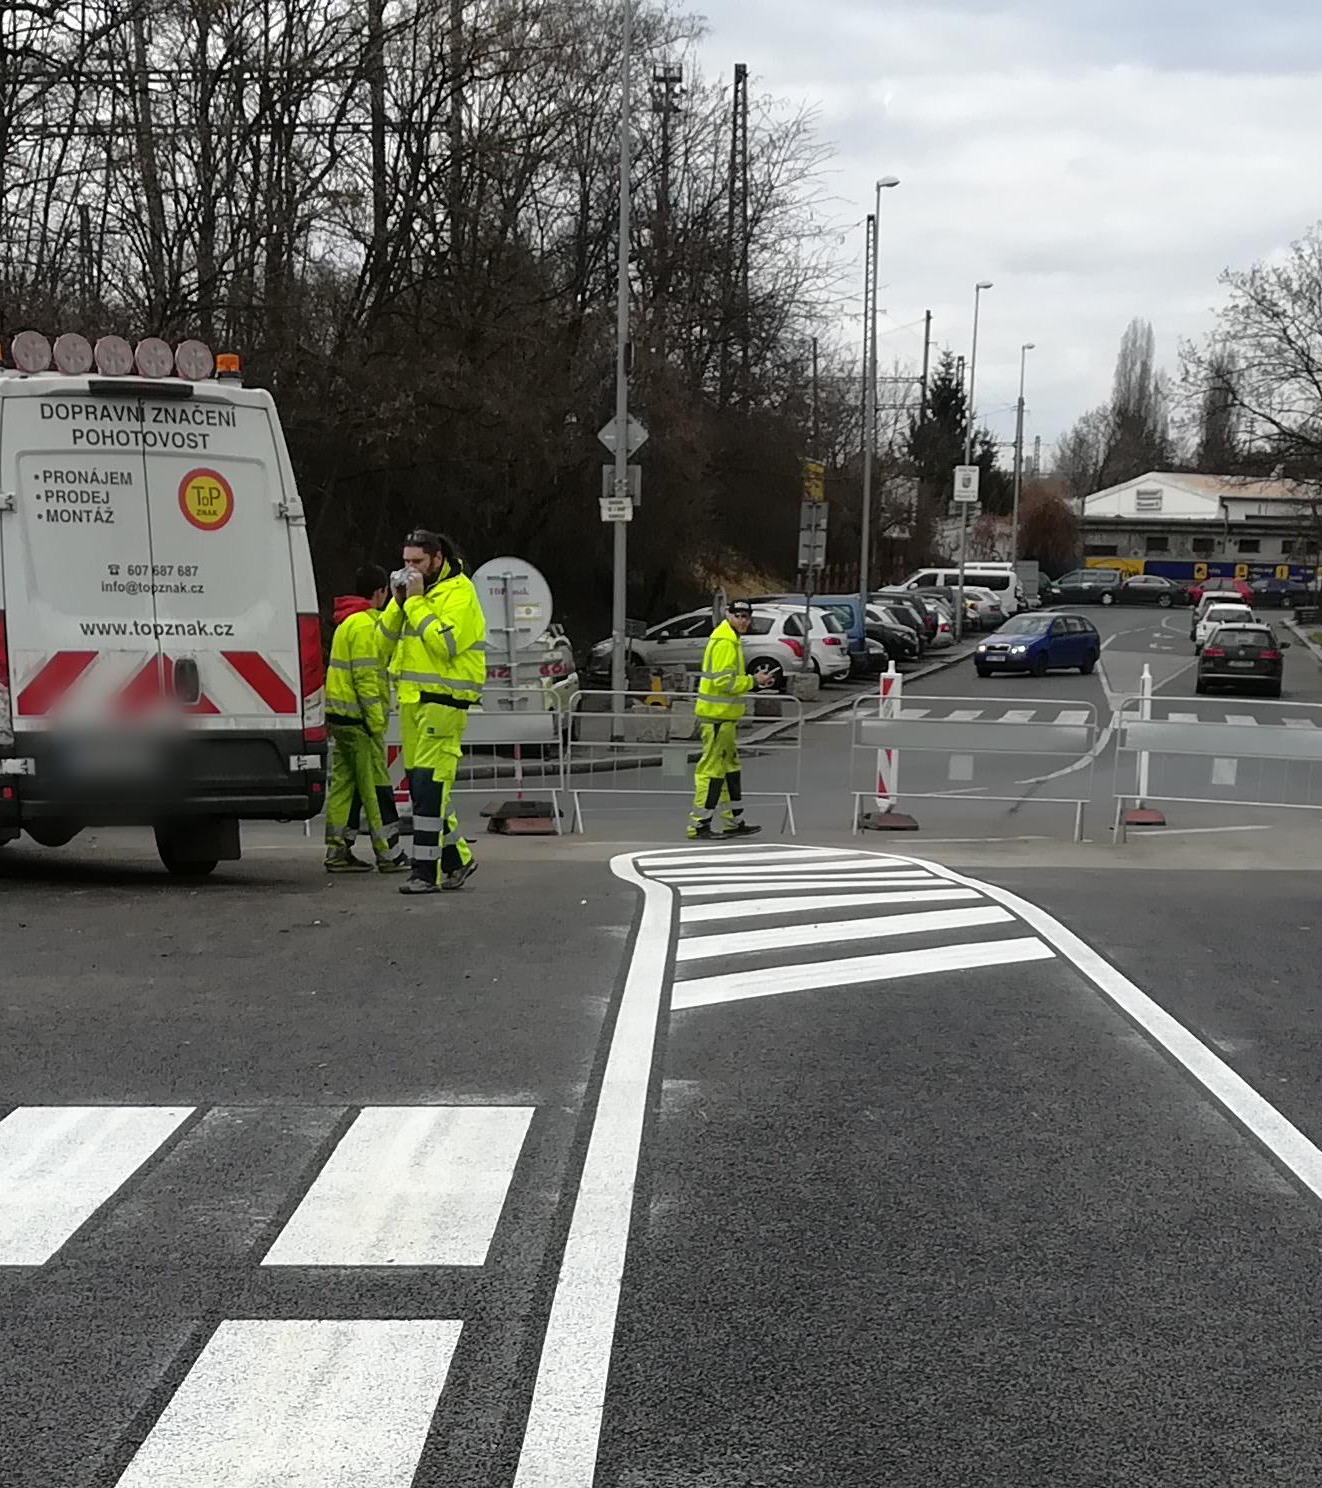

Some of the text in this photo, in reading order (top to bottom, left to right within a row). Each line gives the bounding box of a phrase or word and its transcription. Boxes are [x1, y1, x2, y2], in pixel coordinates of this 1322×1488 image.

[40, 402, 237, 427] DOPRAVNÍ ZNAČENÍ
[72, 428, 210, 450] POHOTOVOST
[42, 468, 133, 486] PRONÁJEM
[44, 490, 110, 504] PRODEJ
[46, 507, 115, 524] MONTÁŽ
[127, 564, 198, 577] 607 687 687
[101, 581, 205, 595] info@topznak.cz
[80, 620, 235, 640] www.topznak.cz
